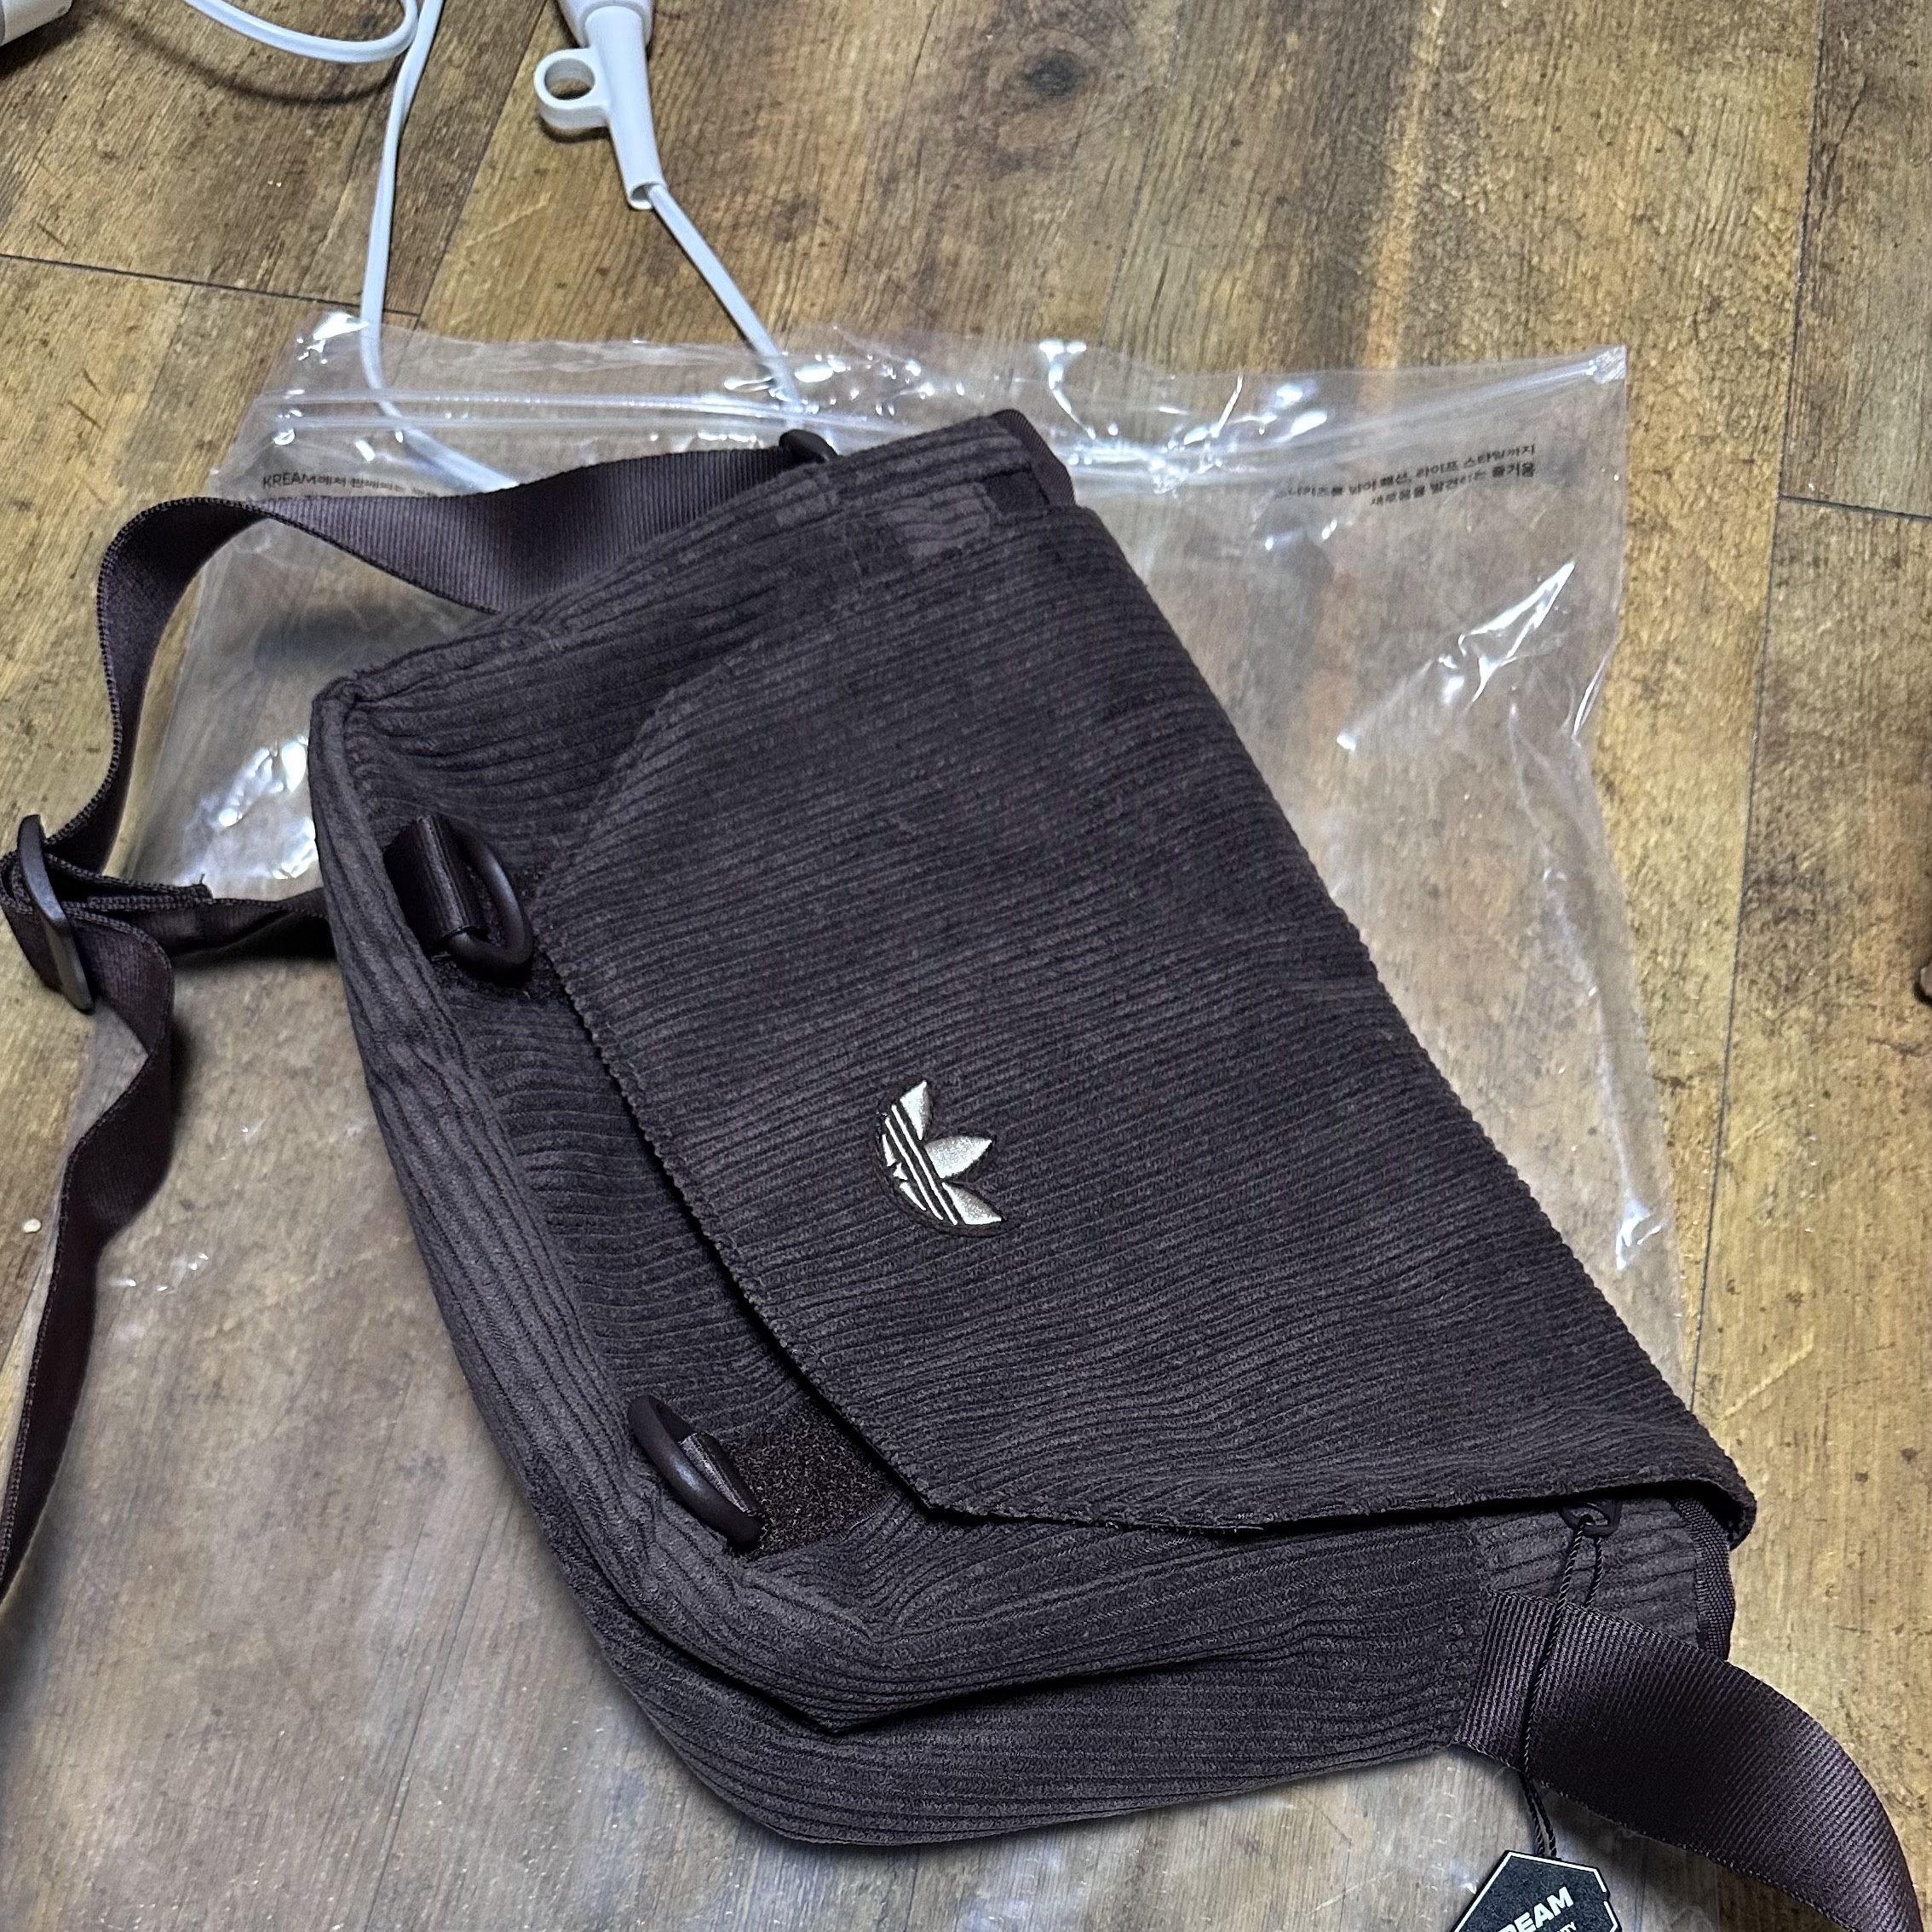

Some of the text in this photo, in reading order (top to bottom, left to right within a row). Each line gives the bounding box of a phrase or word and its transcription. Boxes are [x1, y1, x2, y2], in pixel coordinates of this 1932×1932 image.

[1417, 461, 1459, 477] 라이프
[1463, 443, 1535, 468] 스타일까지
[262, 472, 346, 489] KREAM에서
